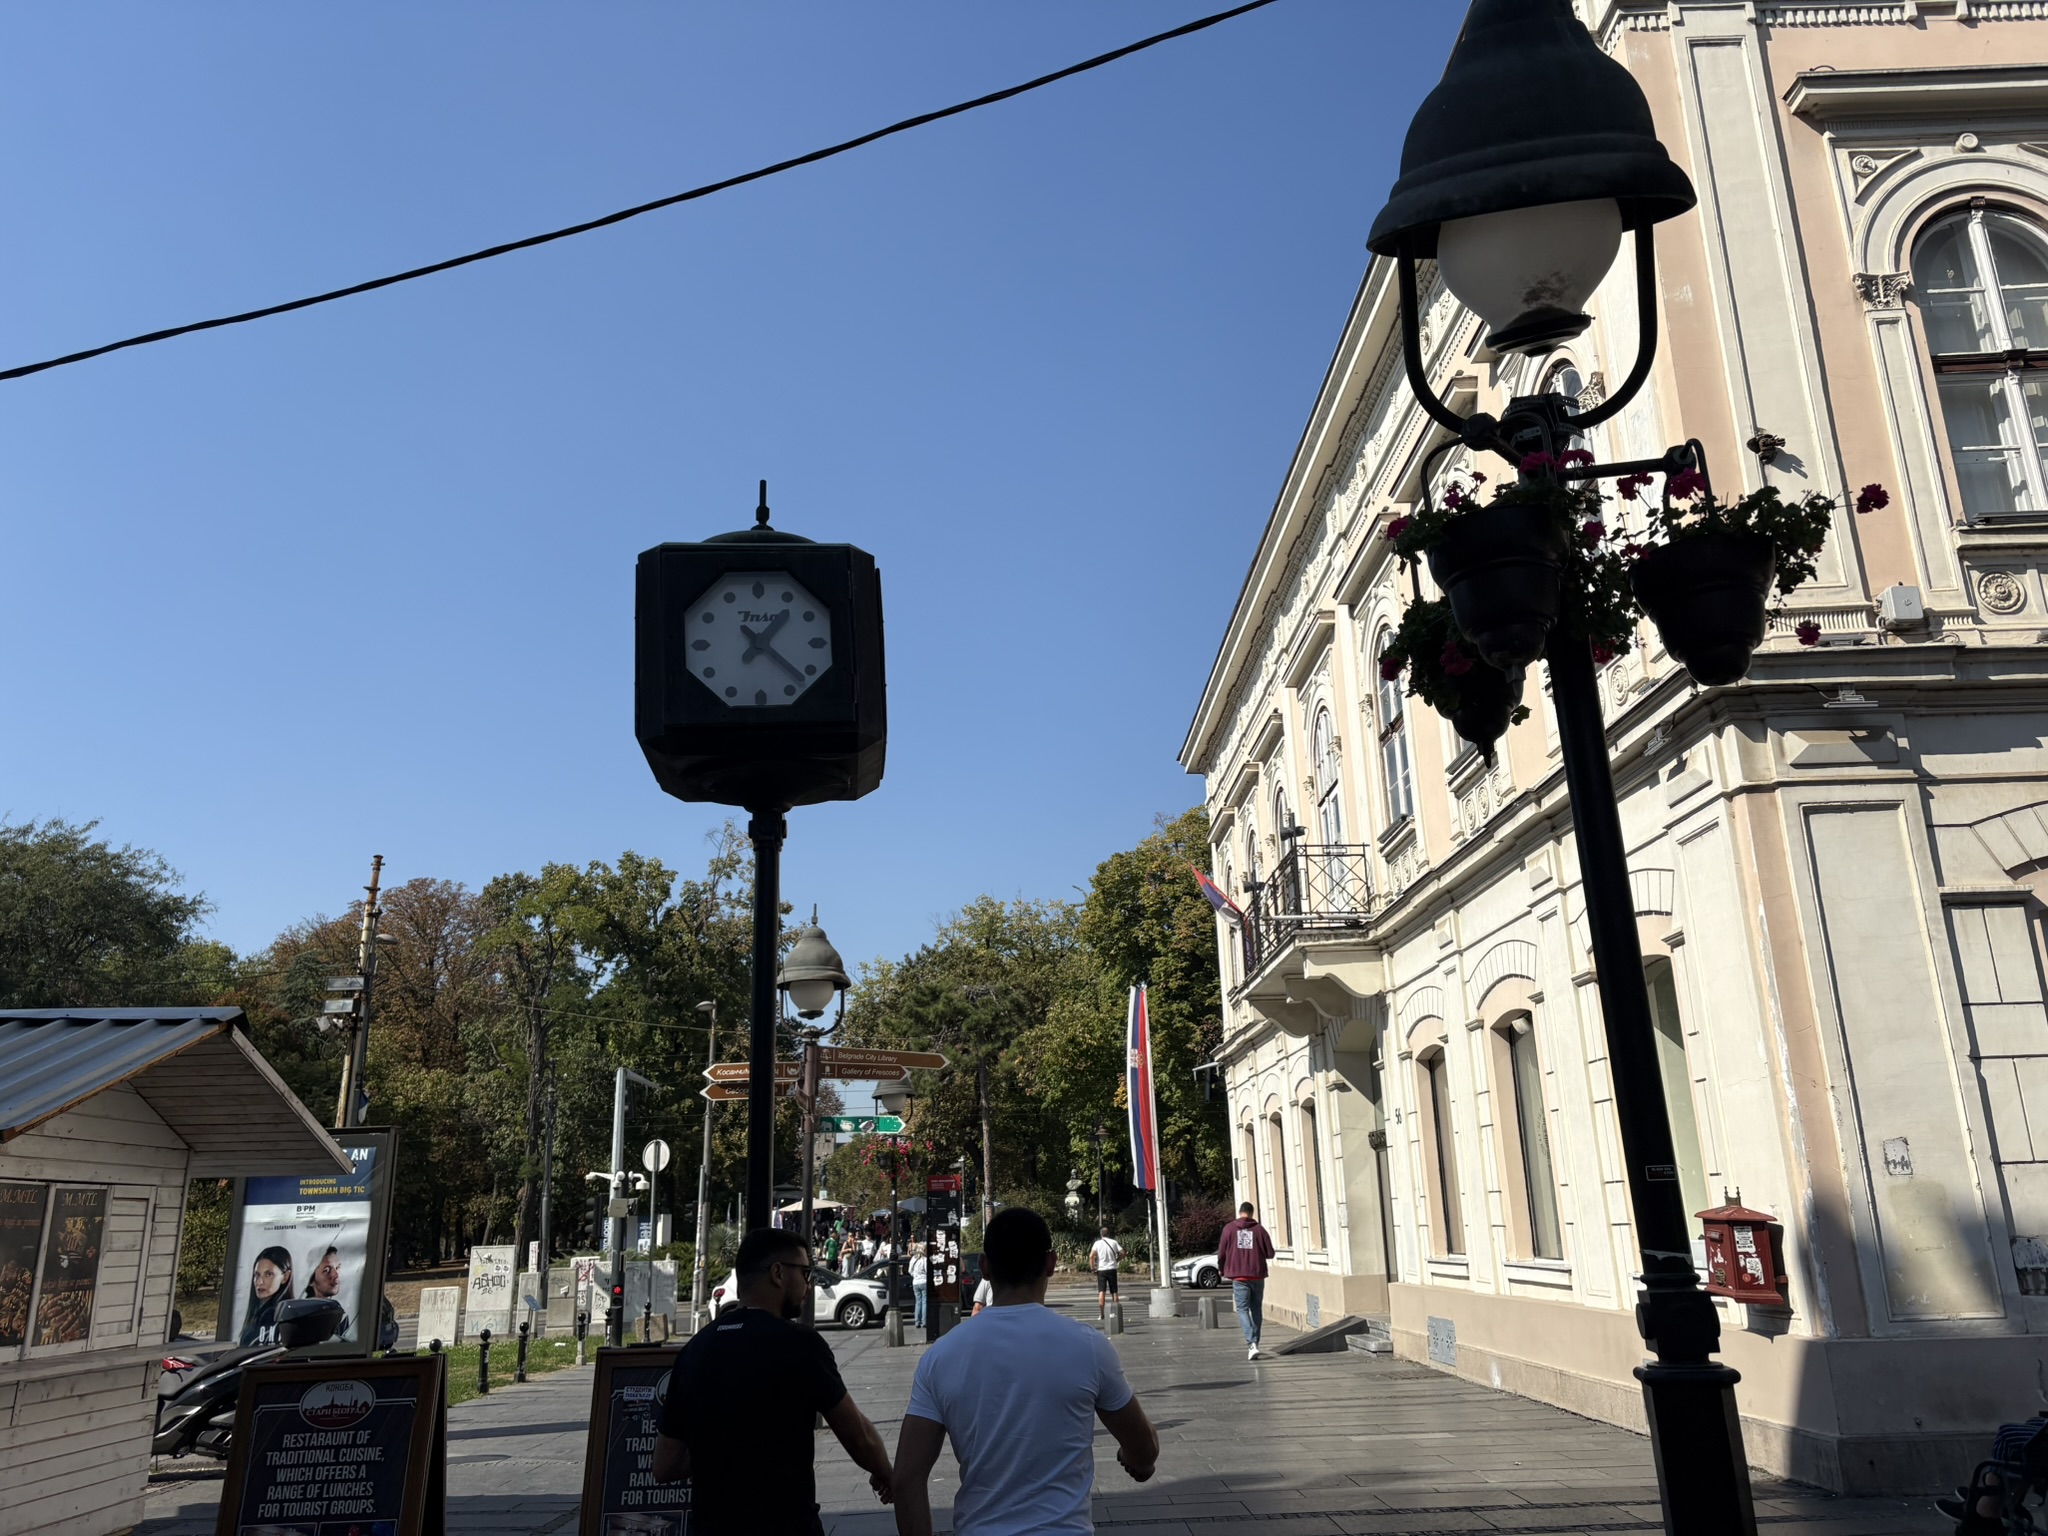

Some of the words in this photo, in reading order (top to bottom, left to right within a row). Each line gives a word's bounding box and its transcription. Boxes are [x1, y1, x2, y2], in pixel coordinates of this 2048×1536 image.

[838, 1051, 864, 1060] Belgrade
[865, 1053, 877, 1062] City
[877, 1054, 898, 1063] Library
[841, 1067, 864, 1076] Gallery
[350, 1148, 369, 1161] AN
[299, 1178, 337, 1186] INTRODUCING
[299, 1186, 338, 1196] TOWNSMAN
[339, 1186, 352, 1194] BIG
[353, 1185, 365, 1194] TIC
[306, 1408, 331, 1416] СТАРИ
[282, 1431, 356, 1448] RESTARAUNT
[356, 1430, 372, 1445] OF
[265, 1449, 337, 1466] TRADITIONAL
[338, 1446, 385, 1463] CUISINE,
[276, 1467, 314, 1483] WHICH
[315, 1465, 358, 1481] OFFERS
[358, 1464, 367, 1479] A
[266, 1484, 305, 1501] RANGE
[306, 1483, 322, 1499] OF
[322, 1481, 374, 1498] LUNCHES
[621, 1490, 643, 1506] FOR
[646, 1488, 692, 1504] TOURIST
[257, 1503, 280, 1518] FOR
[282, 1501, 330, 1518] TOURIST
[330, 1499, 376, 1515] GROUPS.
